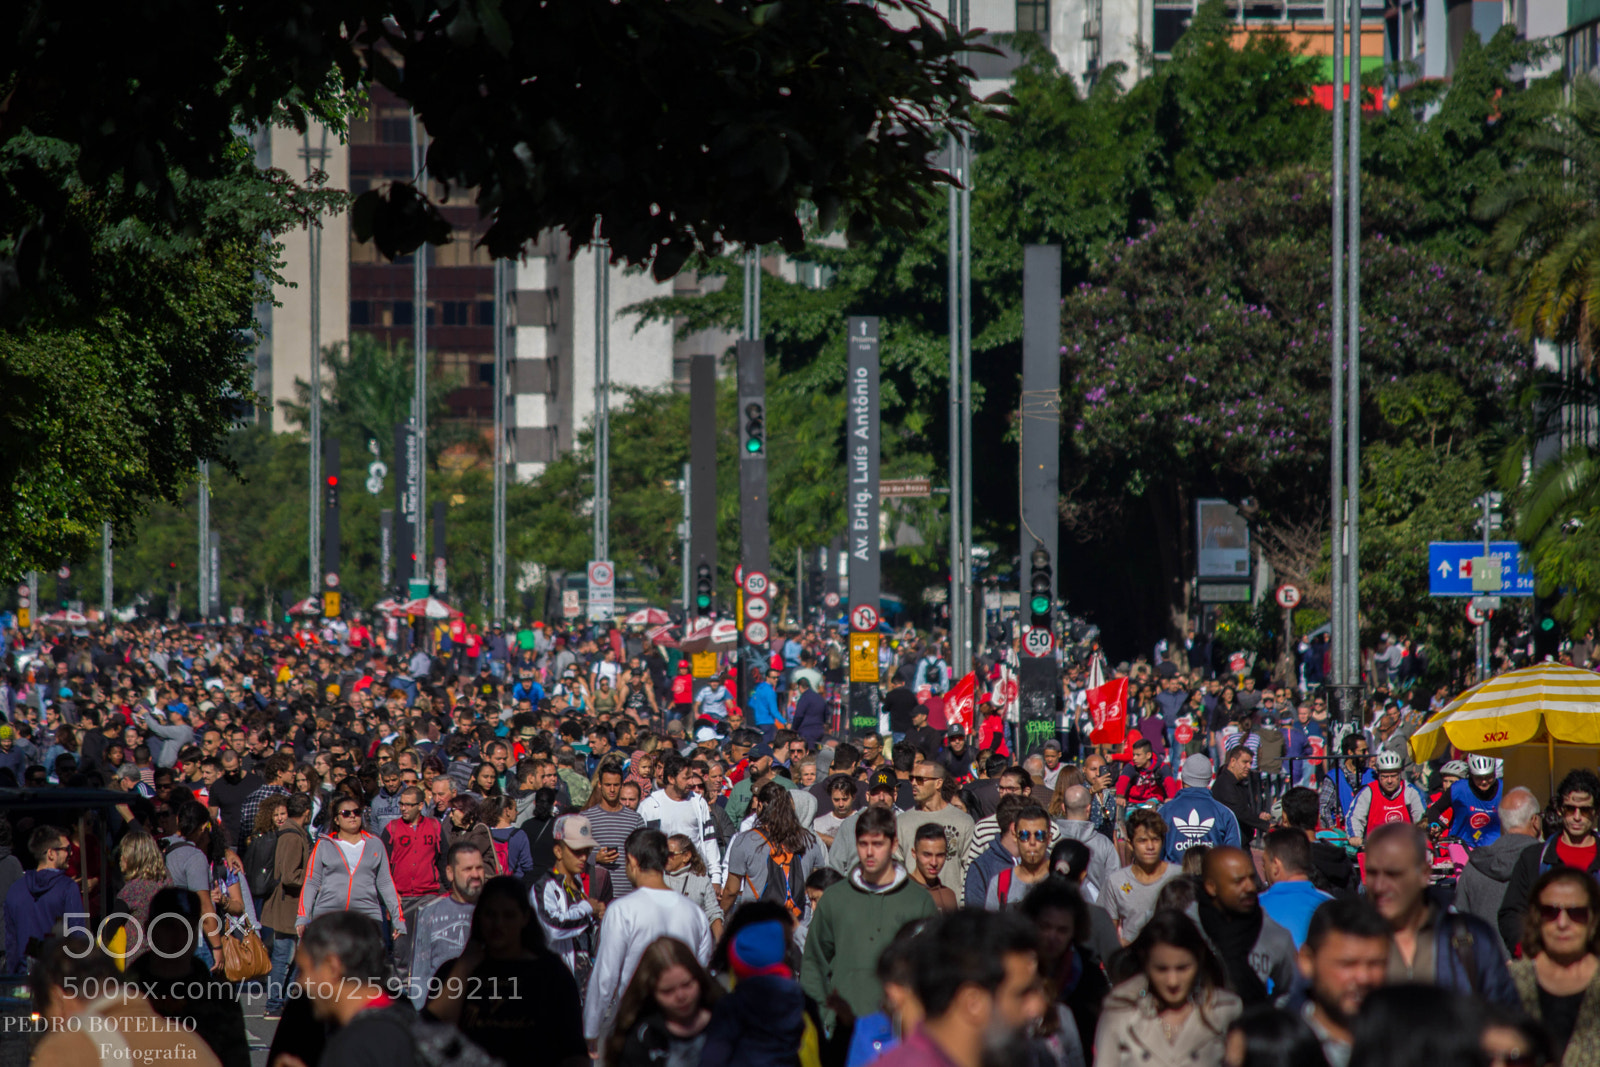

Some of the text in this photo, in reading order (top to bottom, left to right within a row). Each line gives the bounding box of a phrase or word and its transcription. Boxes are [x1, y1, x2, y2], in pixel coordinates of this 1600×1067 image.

[852, 367, 872, 561] Av. Brig. Luís Antônio
[748, 577, 765, 589] 50
[1029, 632, 1050, 647] 50
[1482, 731, 1509, 743] SKOL
[424, 834, 434, 846] 13
